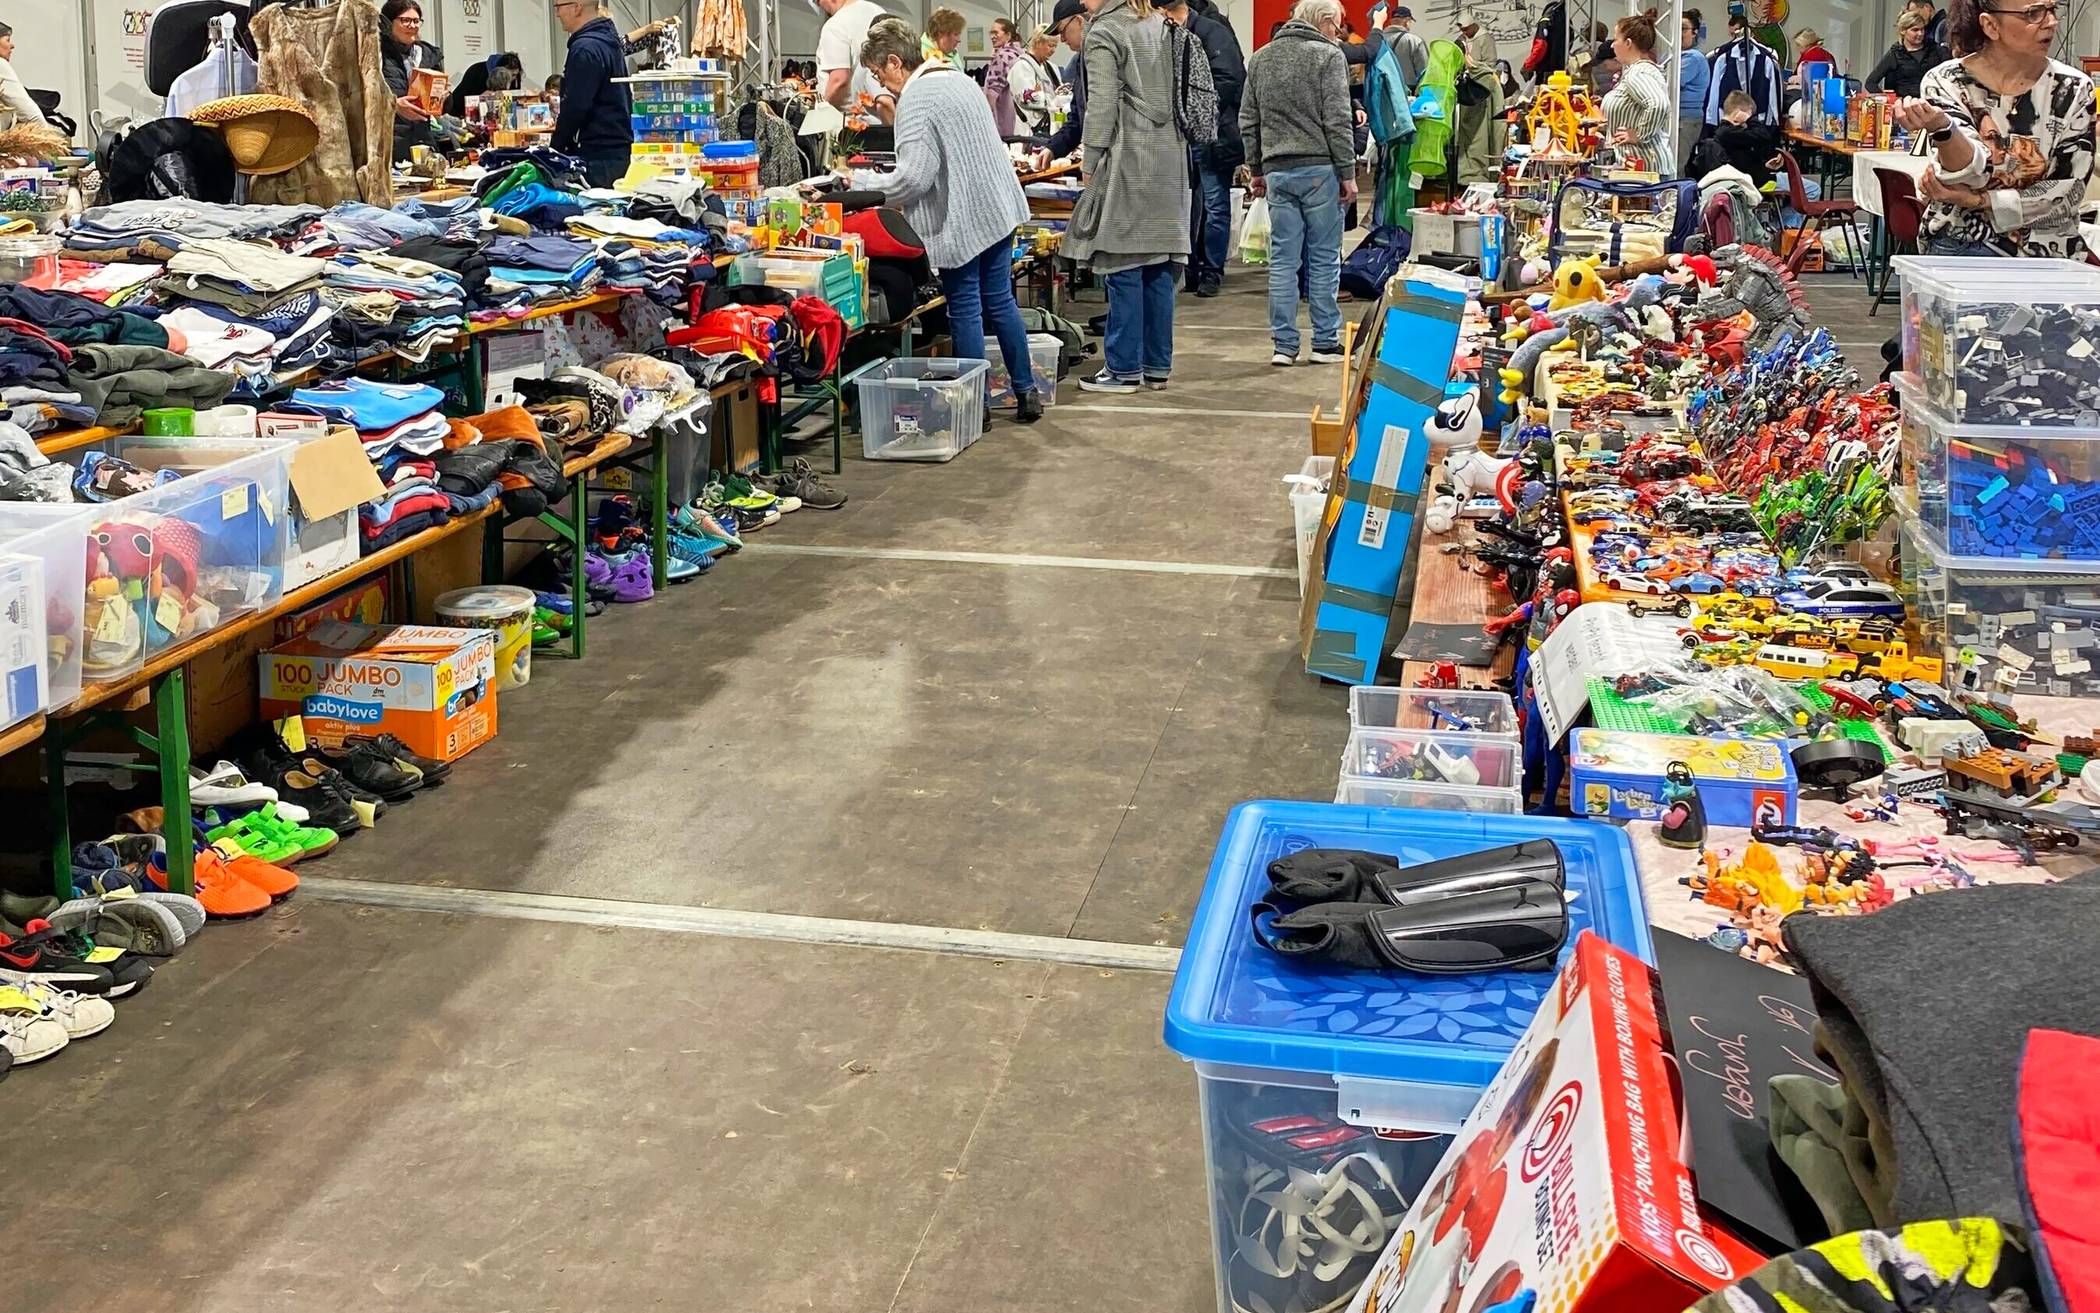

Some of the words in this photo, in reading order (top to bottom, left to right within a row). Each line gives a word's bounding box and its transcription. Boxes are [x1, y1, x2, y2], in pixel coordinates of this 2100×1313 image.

[274, 663, 311, 685] 100
[316, 663, 401, 687] JUMBO
[454, 641, 492, 676] JUMBO
[318, 682, 353, 696] PACK
[436, 669, 452, 689] 100
[455, 669, 475, 686] PACK
[306, 698, 379, 719] babylove
[449, 734, 456, 747] 3
[1605, 953, 1626, 1000] GLOVES
[1611, 997, 1634, 1047] BOXING
[1618, 1044, 1641, 1081] WITH
[1623, 1081, 1646, 1114] BAG
[1626, 1112, 1657, 1198] PUNCHING
[1535, 1175, 1551, 1240] BOXING
[1552, 1143, 1582, 1266] BULLSEYE
[1537, 1230, 1555, 1272] SET
